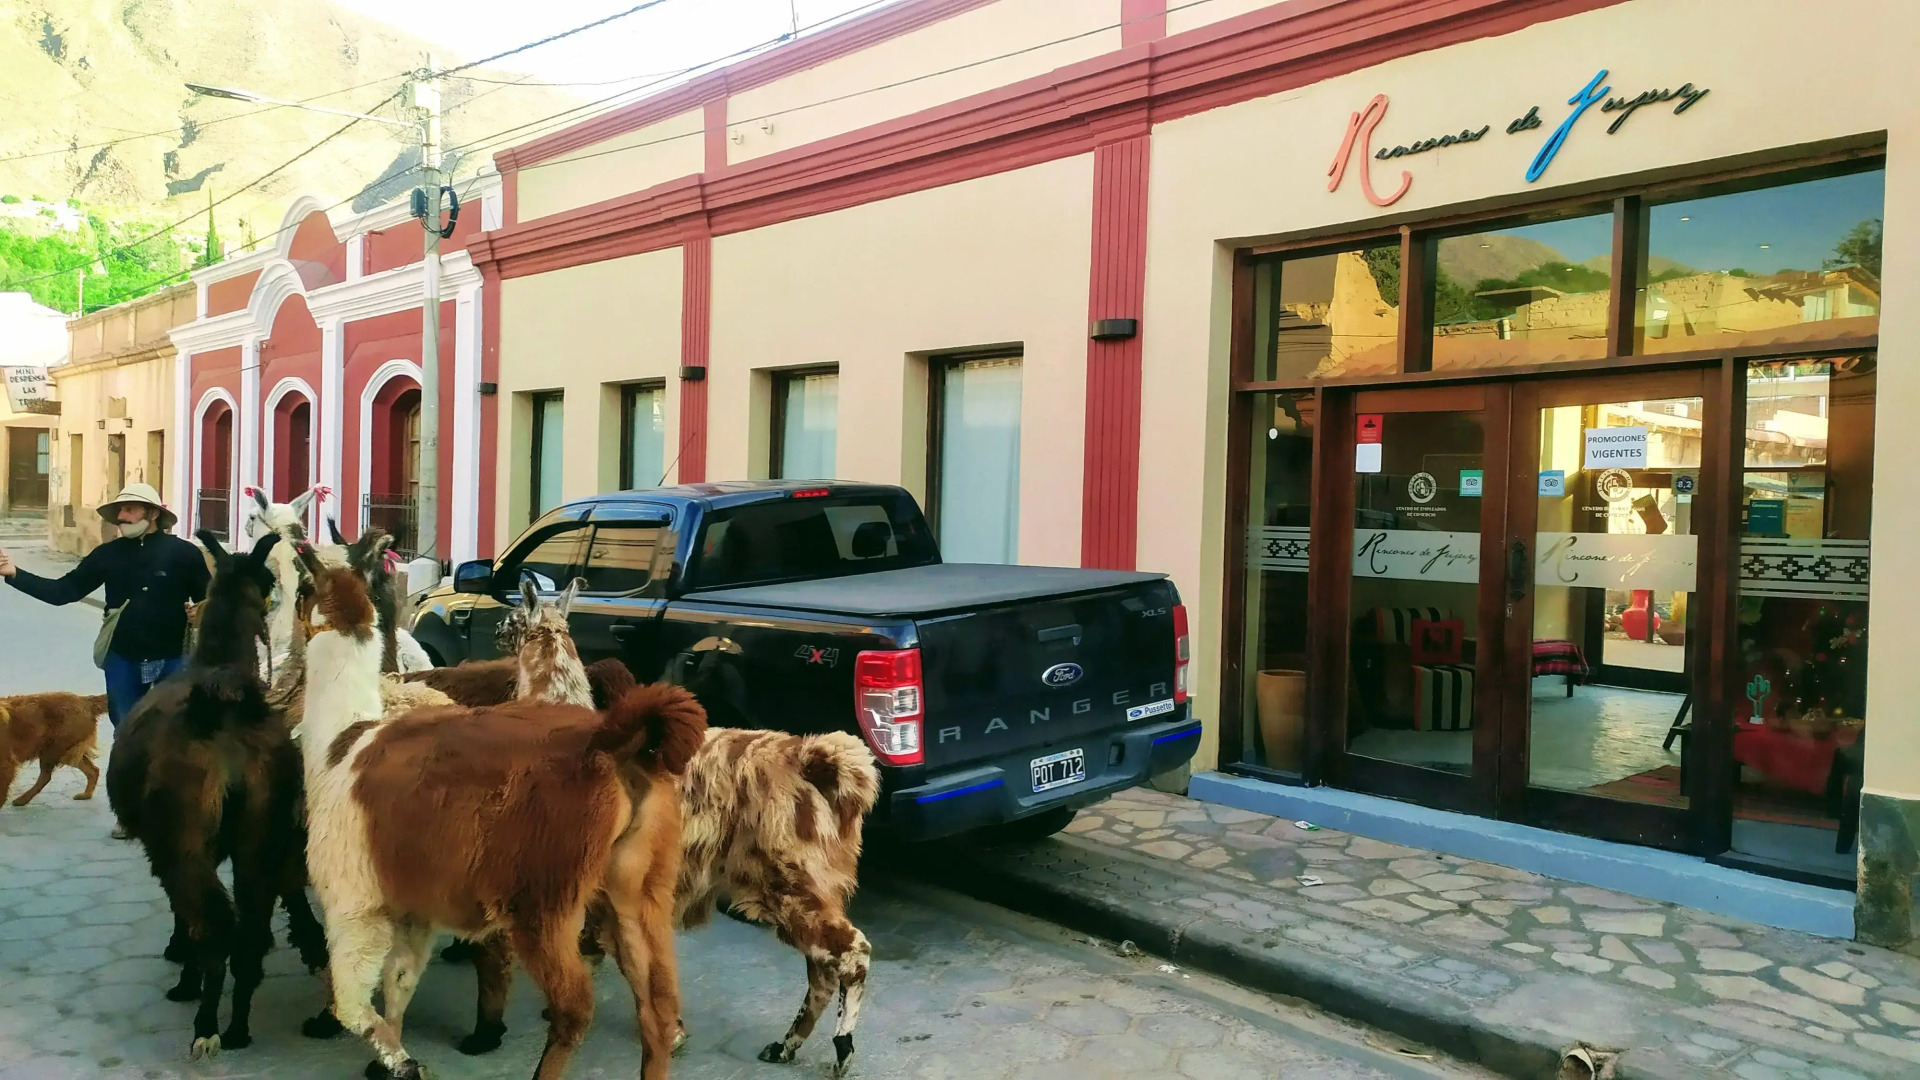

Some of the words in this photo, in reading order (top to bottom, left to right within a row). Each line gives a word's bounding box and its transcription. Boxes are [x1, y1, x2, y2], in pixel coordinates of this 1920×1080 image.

[1505, 106, 1542, 135] de
[10, 375, 46, 383] DESPENSA
[1587, 434, 1646, 444] PROMOCIONES
[1592, 448, 1642, 459] VIGENTES
[1357, 532, 1417, 575] Rincones
[1542, 535, 1616, 583] Rincones
[1141, 607, 1167, 618] XLS
[1053, 667, 1076, 682] Ford
[938, 682, 1167, 744] RANGER
[1033, 763, 1054, 786] POT
[1060, 757, 1083, 778] 712
